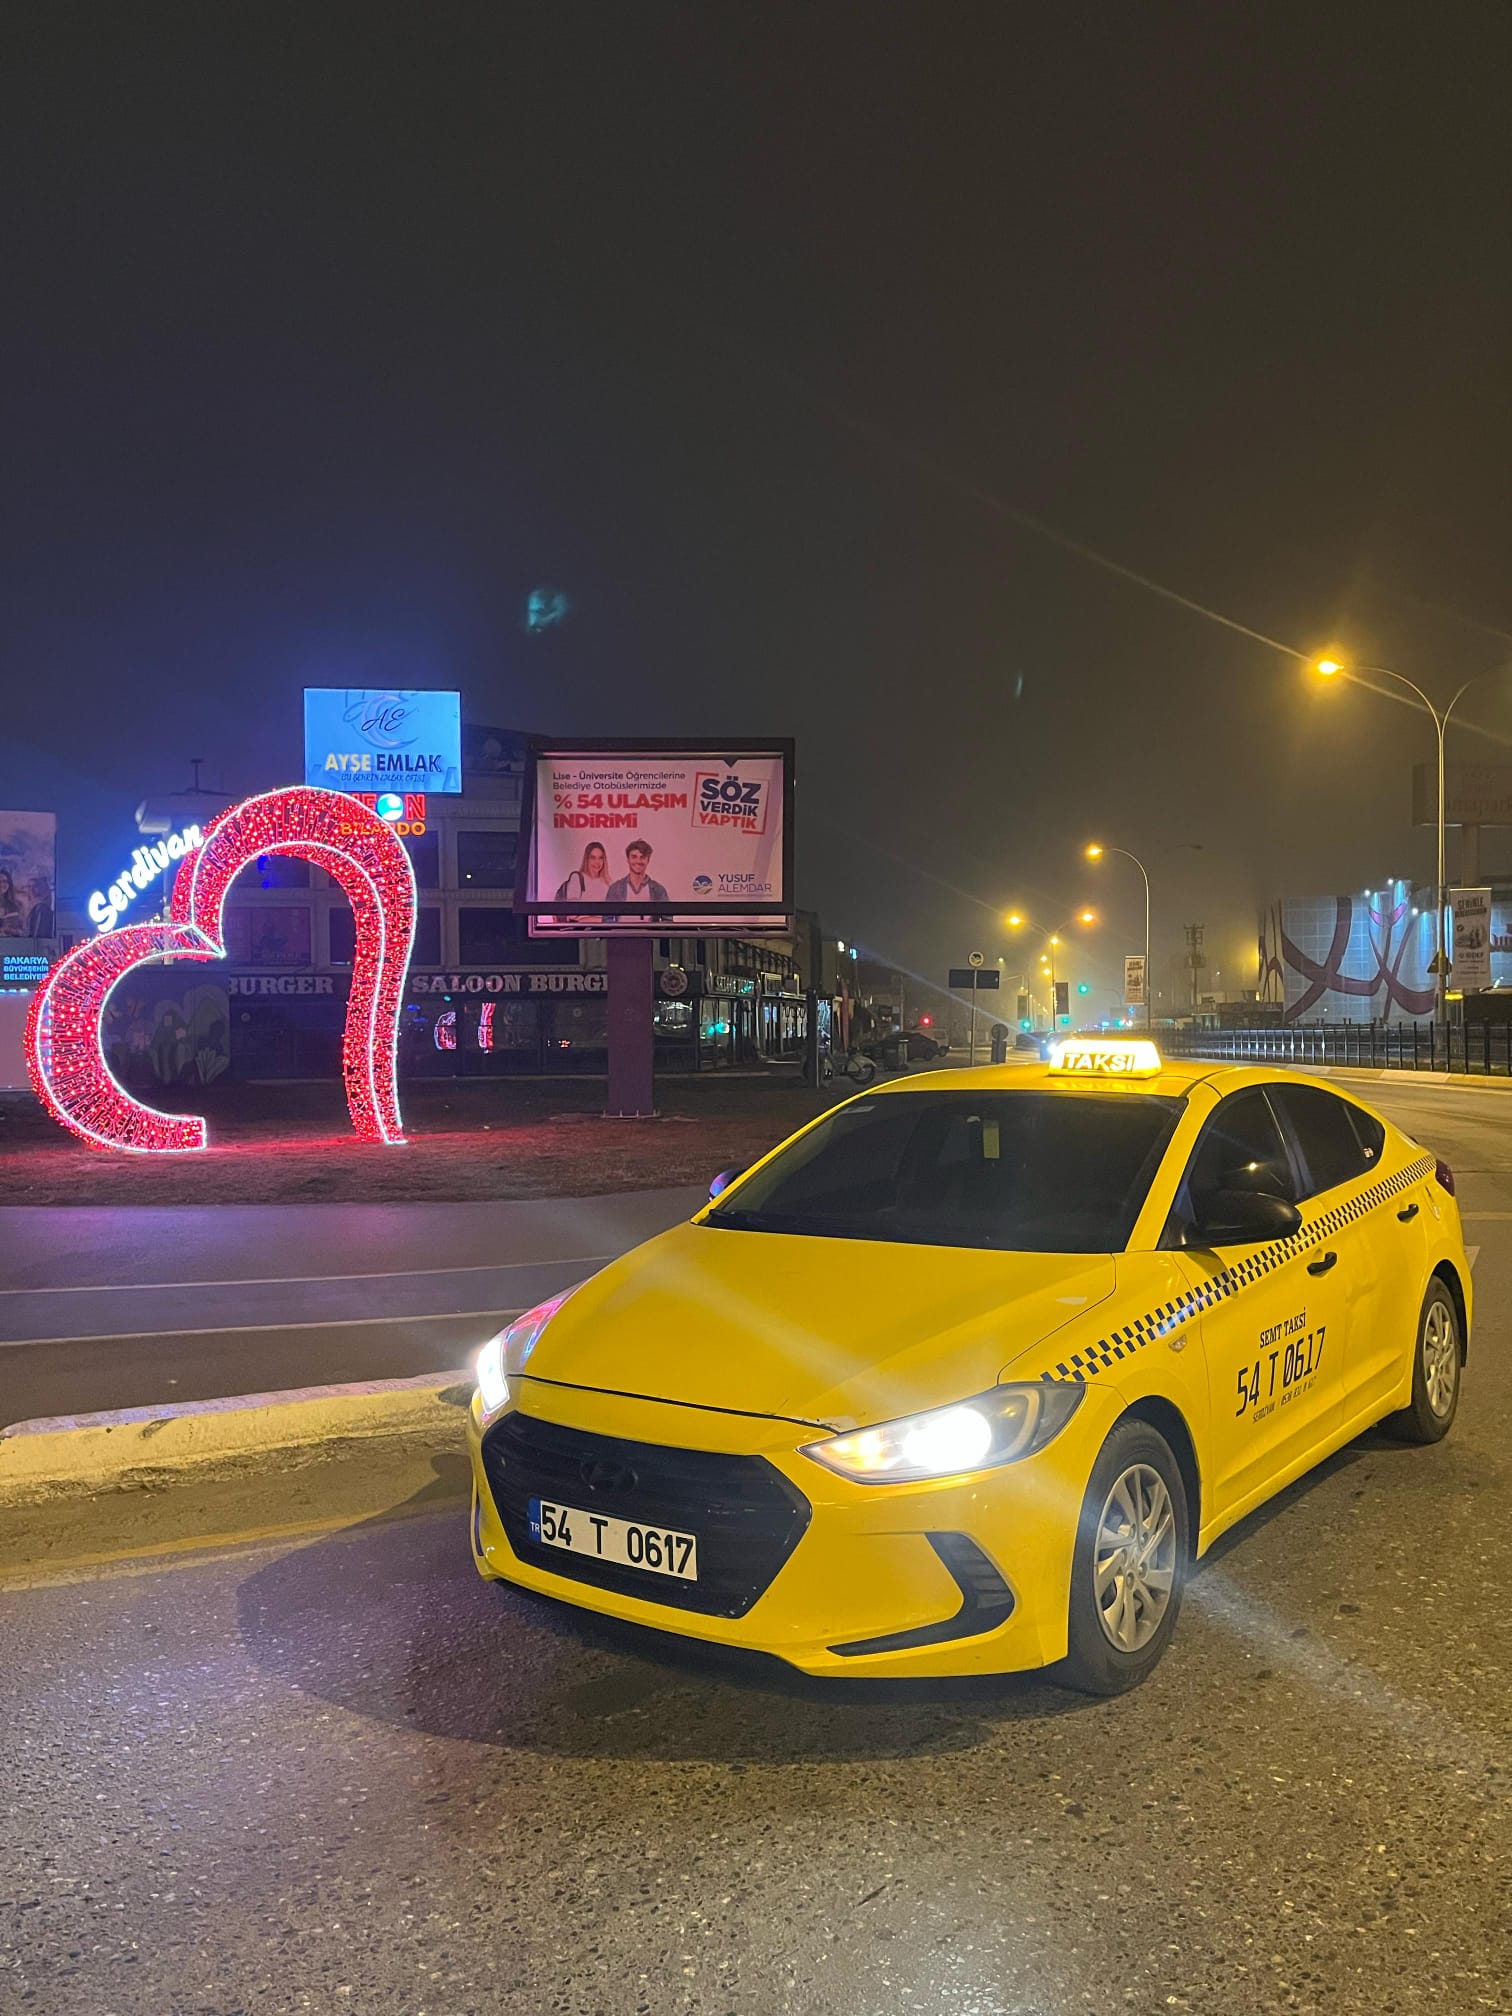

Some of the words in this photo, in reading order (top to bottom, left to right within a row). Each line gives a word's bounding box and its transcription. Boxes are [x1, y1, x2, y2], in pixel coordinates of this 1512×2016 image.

[325, 753, 371, 773] AYŞE
[376, 754, 442, 772] EMLAK
[553, 772, 571, 780] Lise
[579, 771, 623, 780] Üniversite
[626, 771, 685, 782] Öğrencilerine
[553, 782, 591, 791] Belediye
[593, 782, 667, 790] Otobüslerimizde
[700, 776, 762, 804] SÖZ
[554, 794, 573, 809] %
[577, 794, 603, 809] 54
[608, 793, 687, 811] ULAŞIM
[700, 800, 758, 817] VERDİK
[553, 813, 638, 828] İNDİRİMİ
[699, 812, 757, 829] YAPTIK
[88, 825, 204, 932] Serdivan
[718, 874, 755, 882] YUSUF
[718, 883, 772, 893] ALEMDAR
[3, 956, 48, 965] SAKARYA
[412, 975, 521, 993] SALOON
[1260, 1323, 1282, 1349] SEMT
[1284, 1306, 1306, 1336] TAKSİ
[1235, 1360, 1260, 1417] 54
[1269, 1350, 1279, 1397] T
[1282, 1326, 1326, 1388] 0617
[530, 1521, 540, 1534] TR
[542, 1504, 572, 1547] 54
[590, 1517, 608, 1555] T
[627, 1526, 694, 1574] 0617
